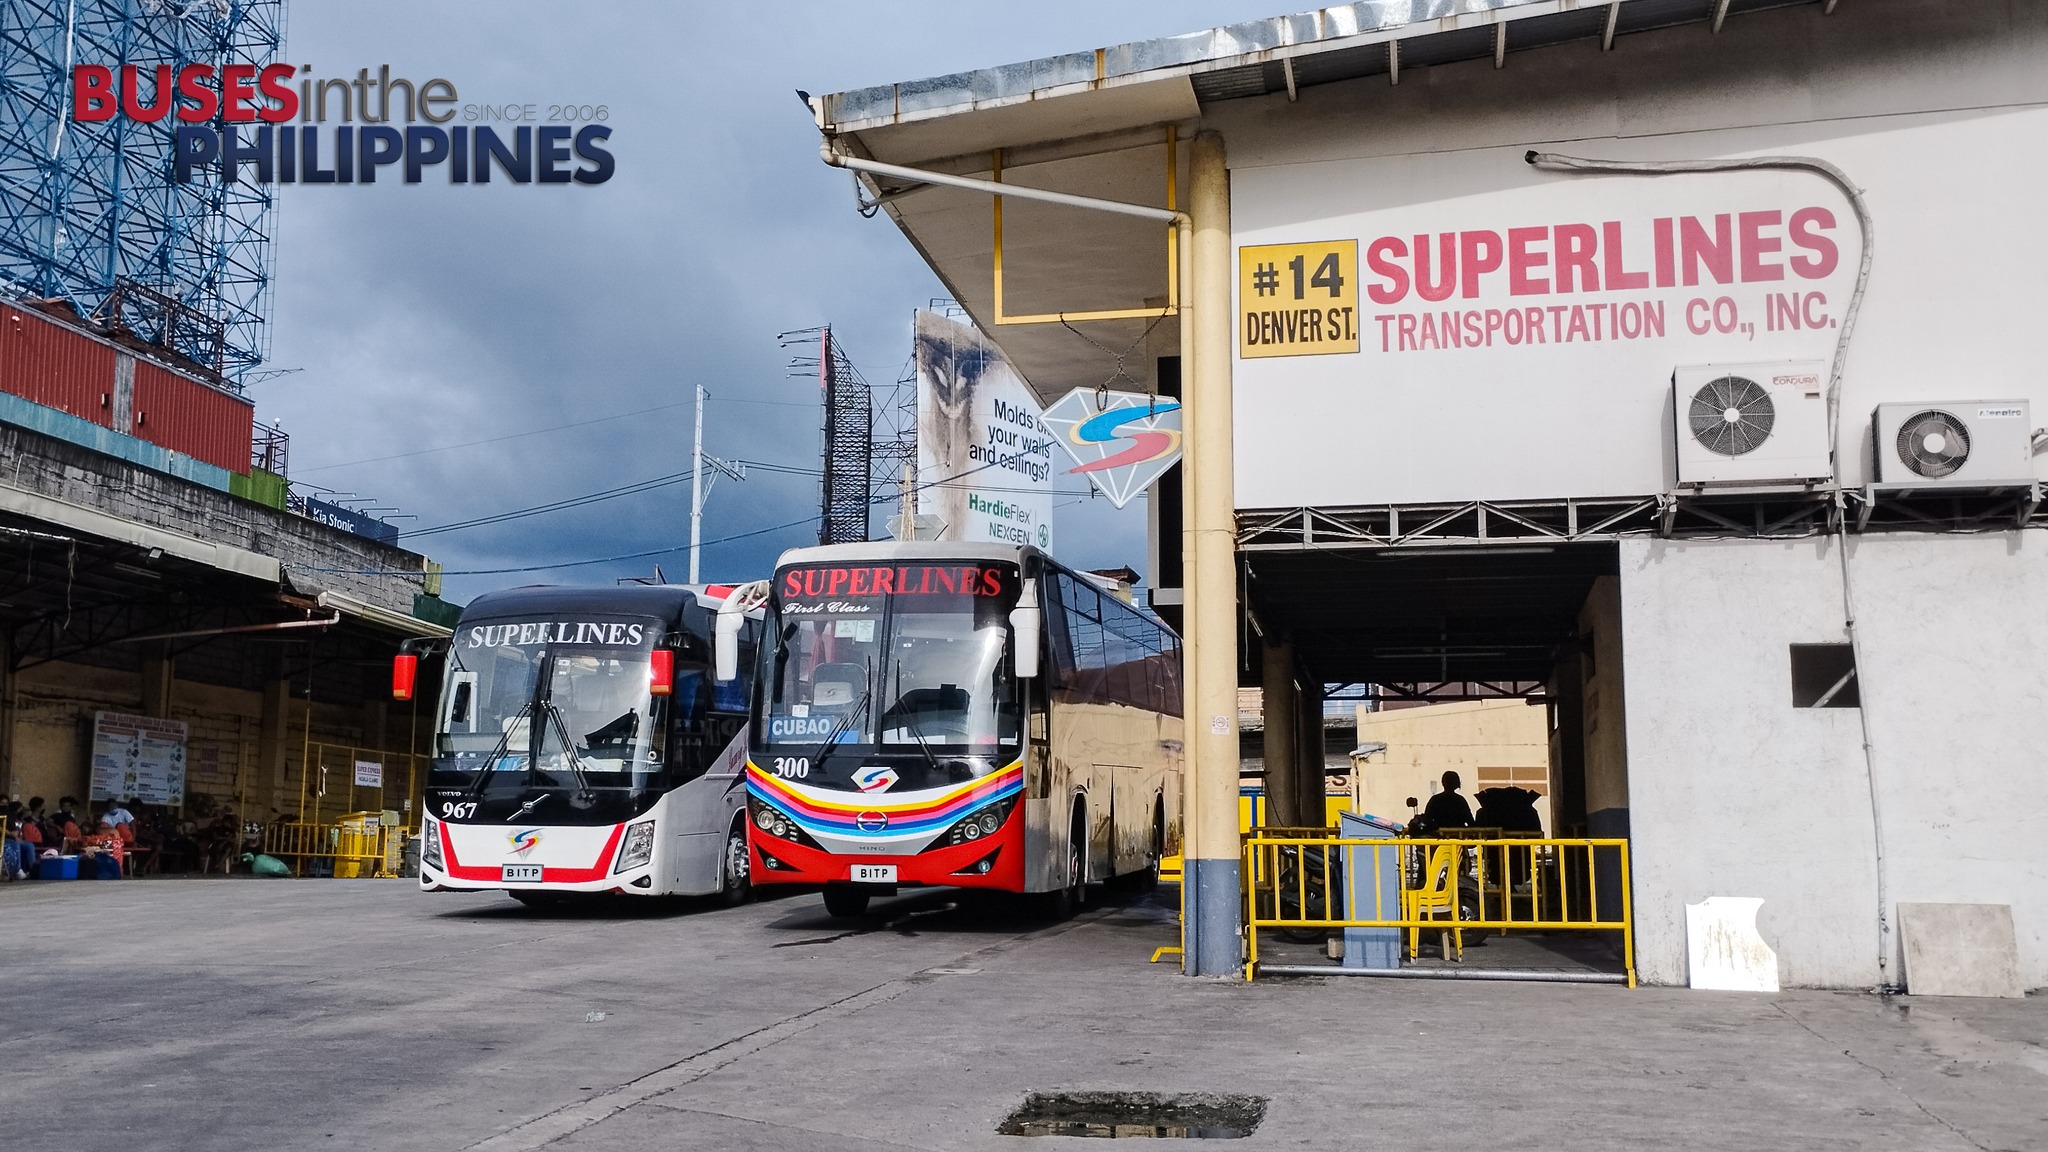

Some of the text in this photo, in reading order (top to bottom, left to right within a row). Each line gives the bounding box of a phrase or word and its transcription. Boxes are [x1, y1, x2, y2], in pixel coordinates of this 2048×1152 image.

[1367, 207, 1839, 305] SUPERLINES
[1247, 308, 1357, 347] DENVER ST.
[1375, 301, 1666, 353] TRANSPORTATION
[1767, 292, 1837, 331] INC.
[1773, 376, 1818, 385] CONDURA
[994, 398, 1034, 430] Molds
[987, 424, 1050, 459] your walls
[969, 444, 1050, 482] and ceilings?
[313, 507, 355, 533] Kia Stonic
[969, 492, 1031, 525] HardieFlex
[989, 521, 1030, 545] NEXGEN
[783, 566, 1001, 598] SUPERLINES
[781, 601, 870, 614] First Class
[468, 622, 643, 649] SUPERLINES
[772, 718, 831, 736] CUBAO
[771, 757, 809, 778] 300
[442, 801, 478, 819] 967
[507, 867, 540, 878] BITP
[860, 868, 888, 878] BITP
